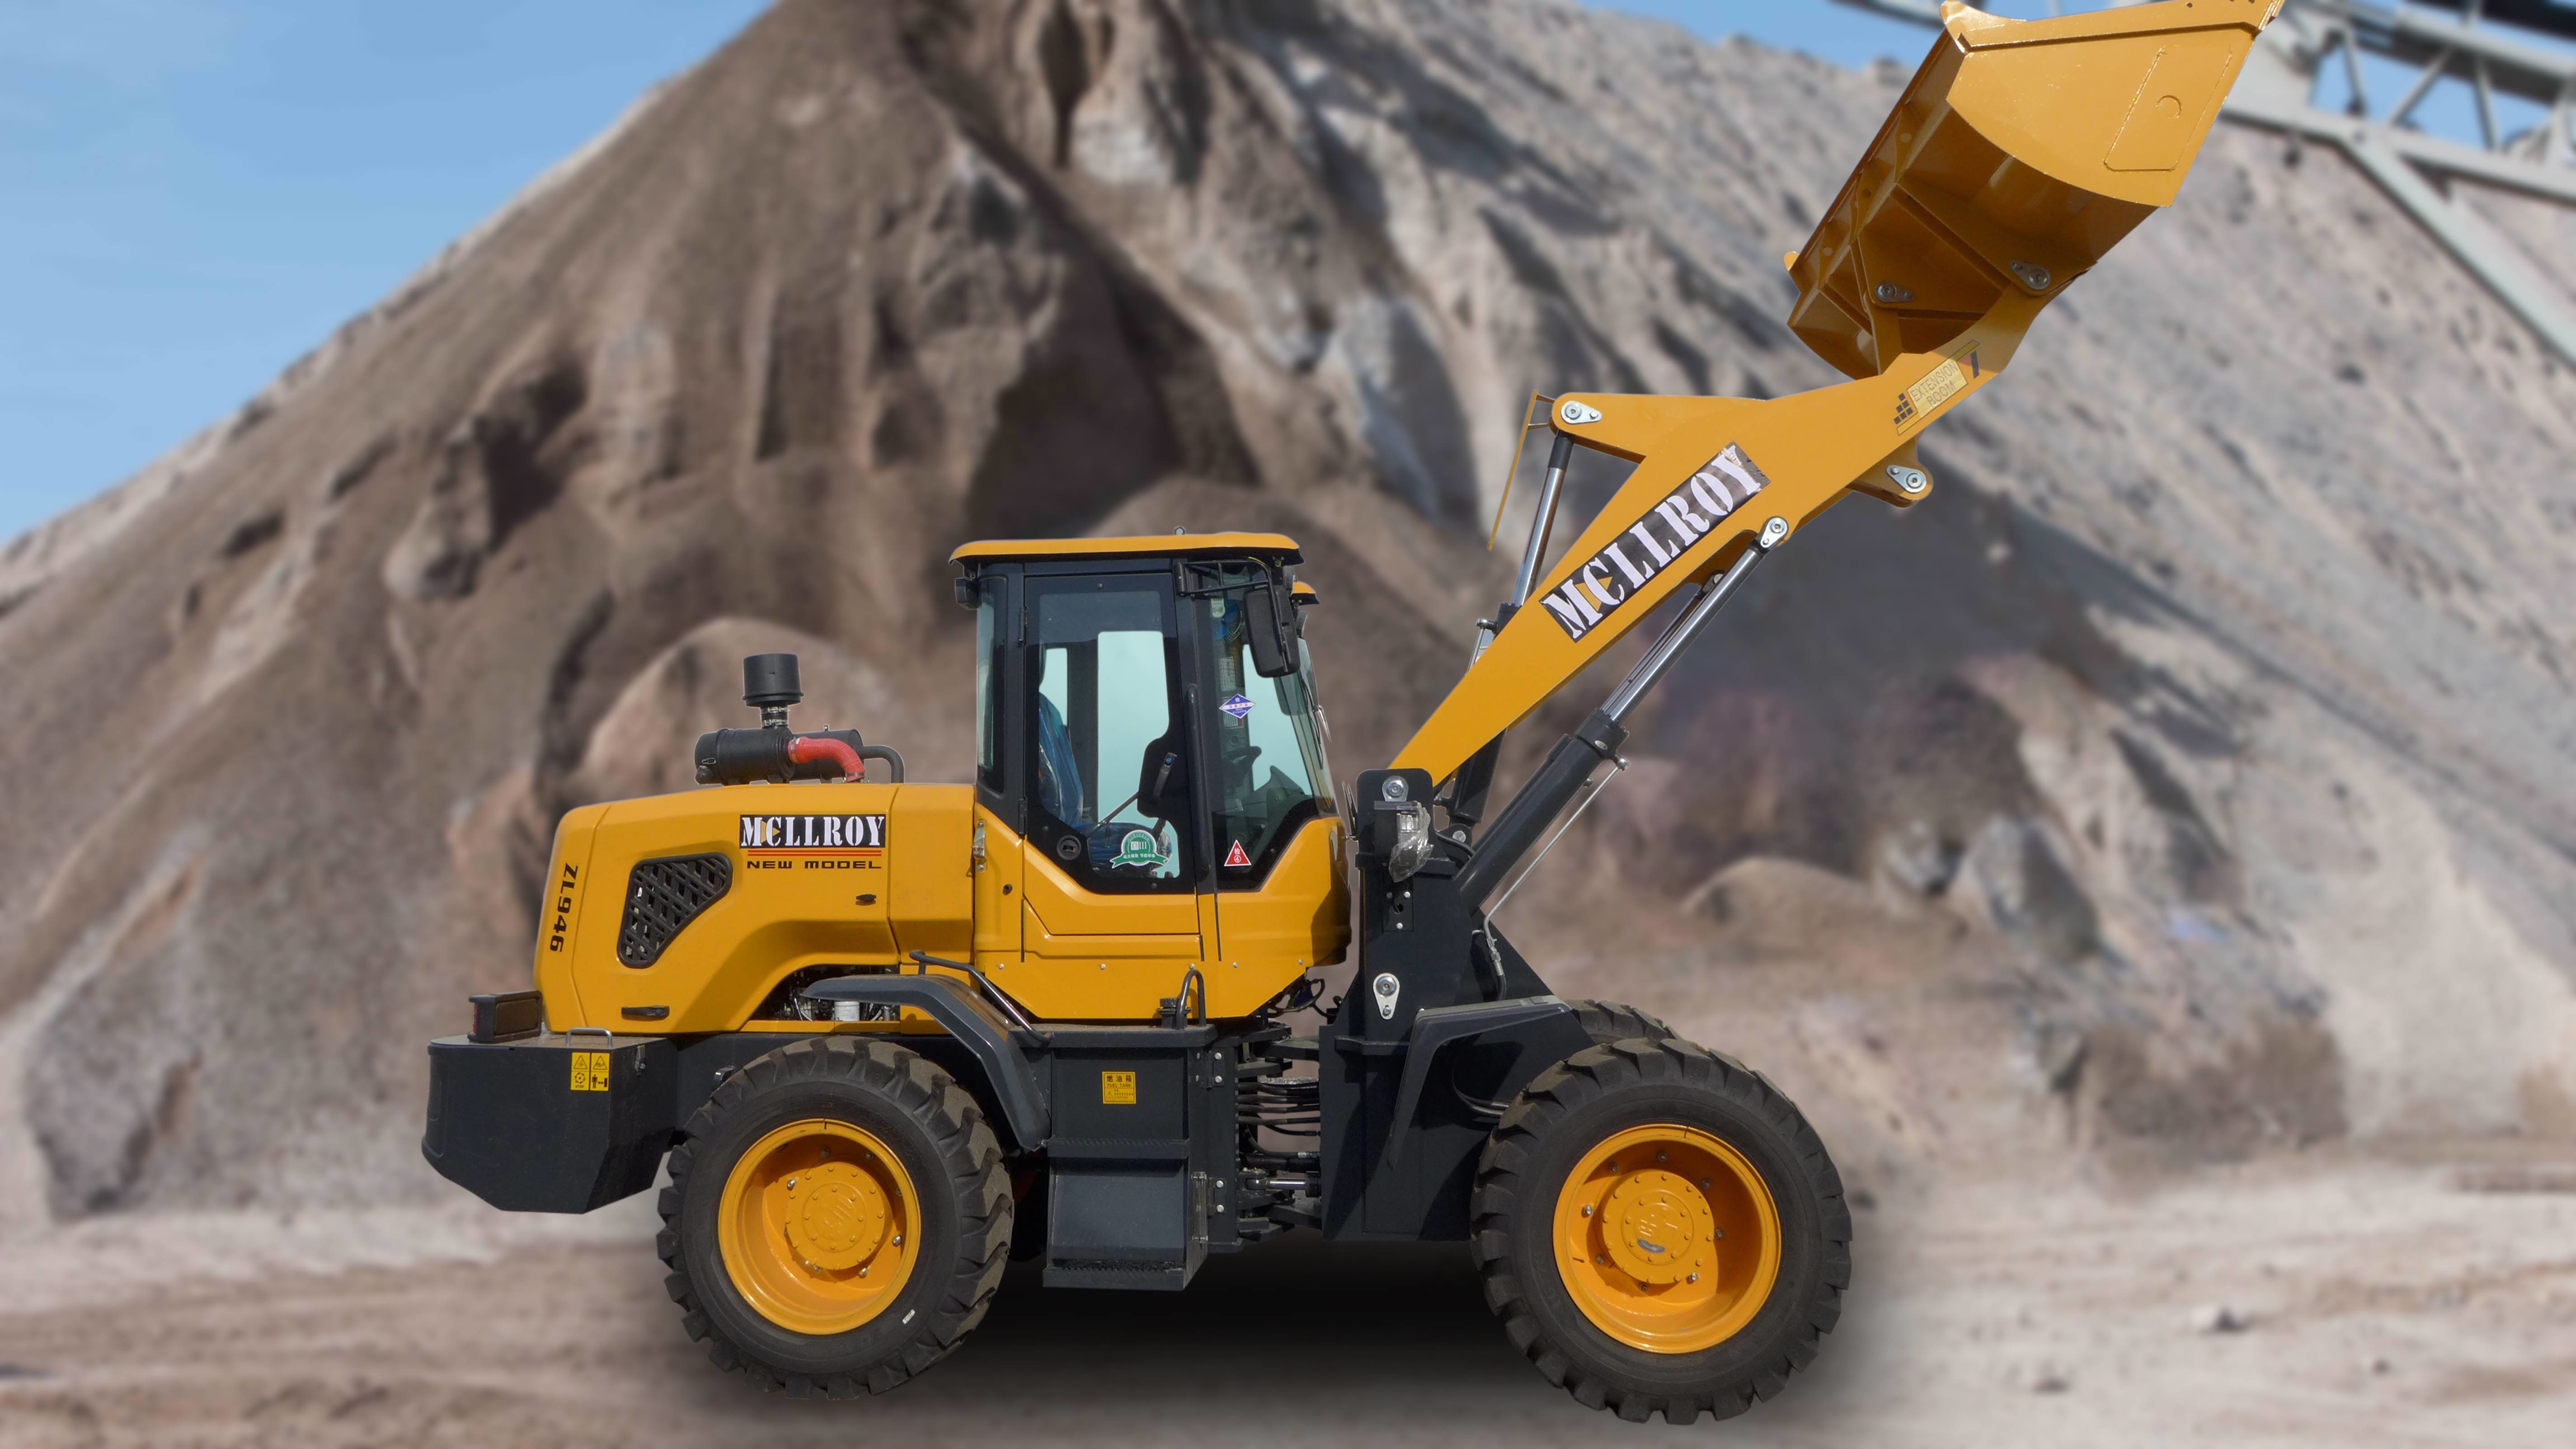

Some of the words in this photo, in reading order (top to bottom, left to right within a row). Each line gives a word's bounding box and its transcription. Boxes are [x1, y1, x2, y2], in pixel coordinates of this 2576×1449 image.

[1911, 362, 1959, 402] EXTENSION
[1927, 381, 1956, 406] BOOM
[741, 816, 884, 847] MCLLROY
[550, 863, 578, 952] ZL946
